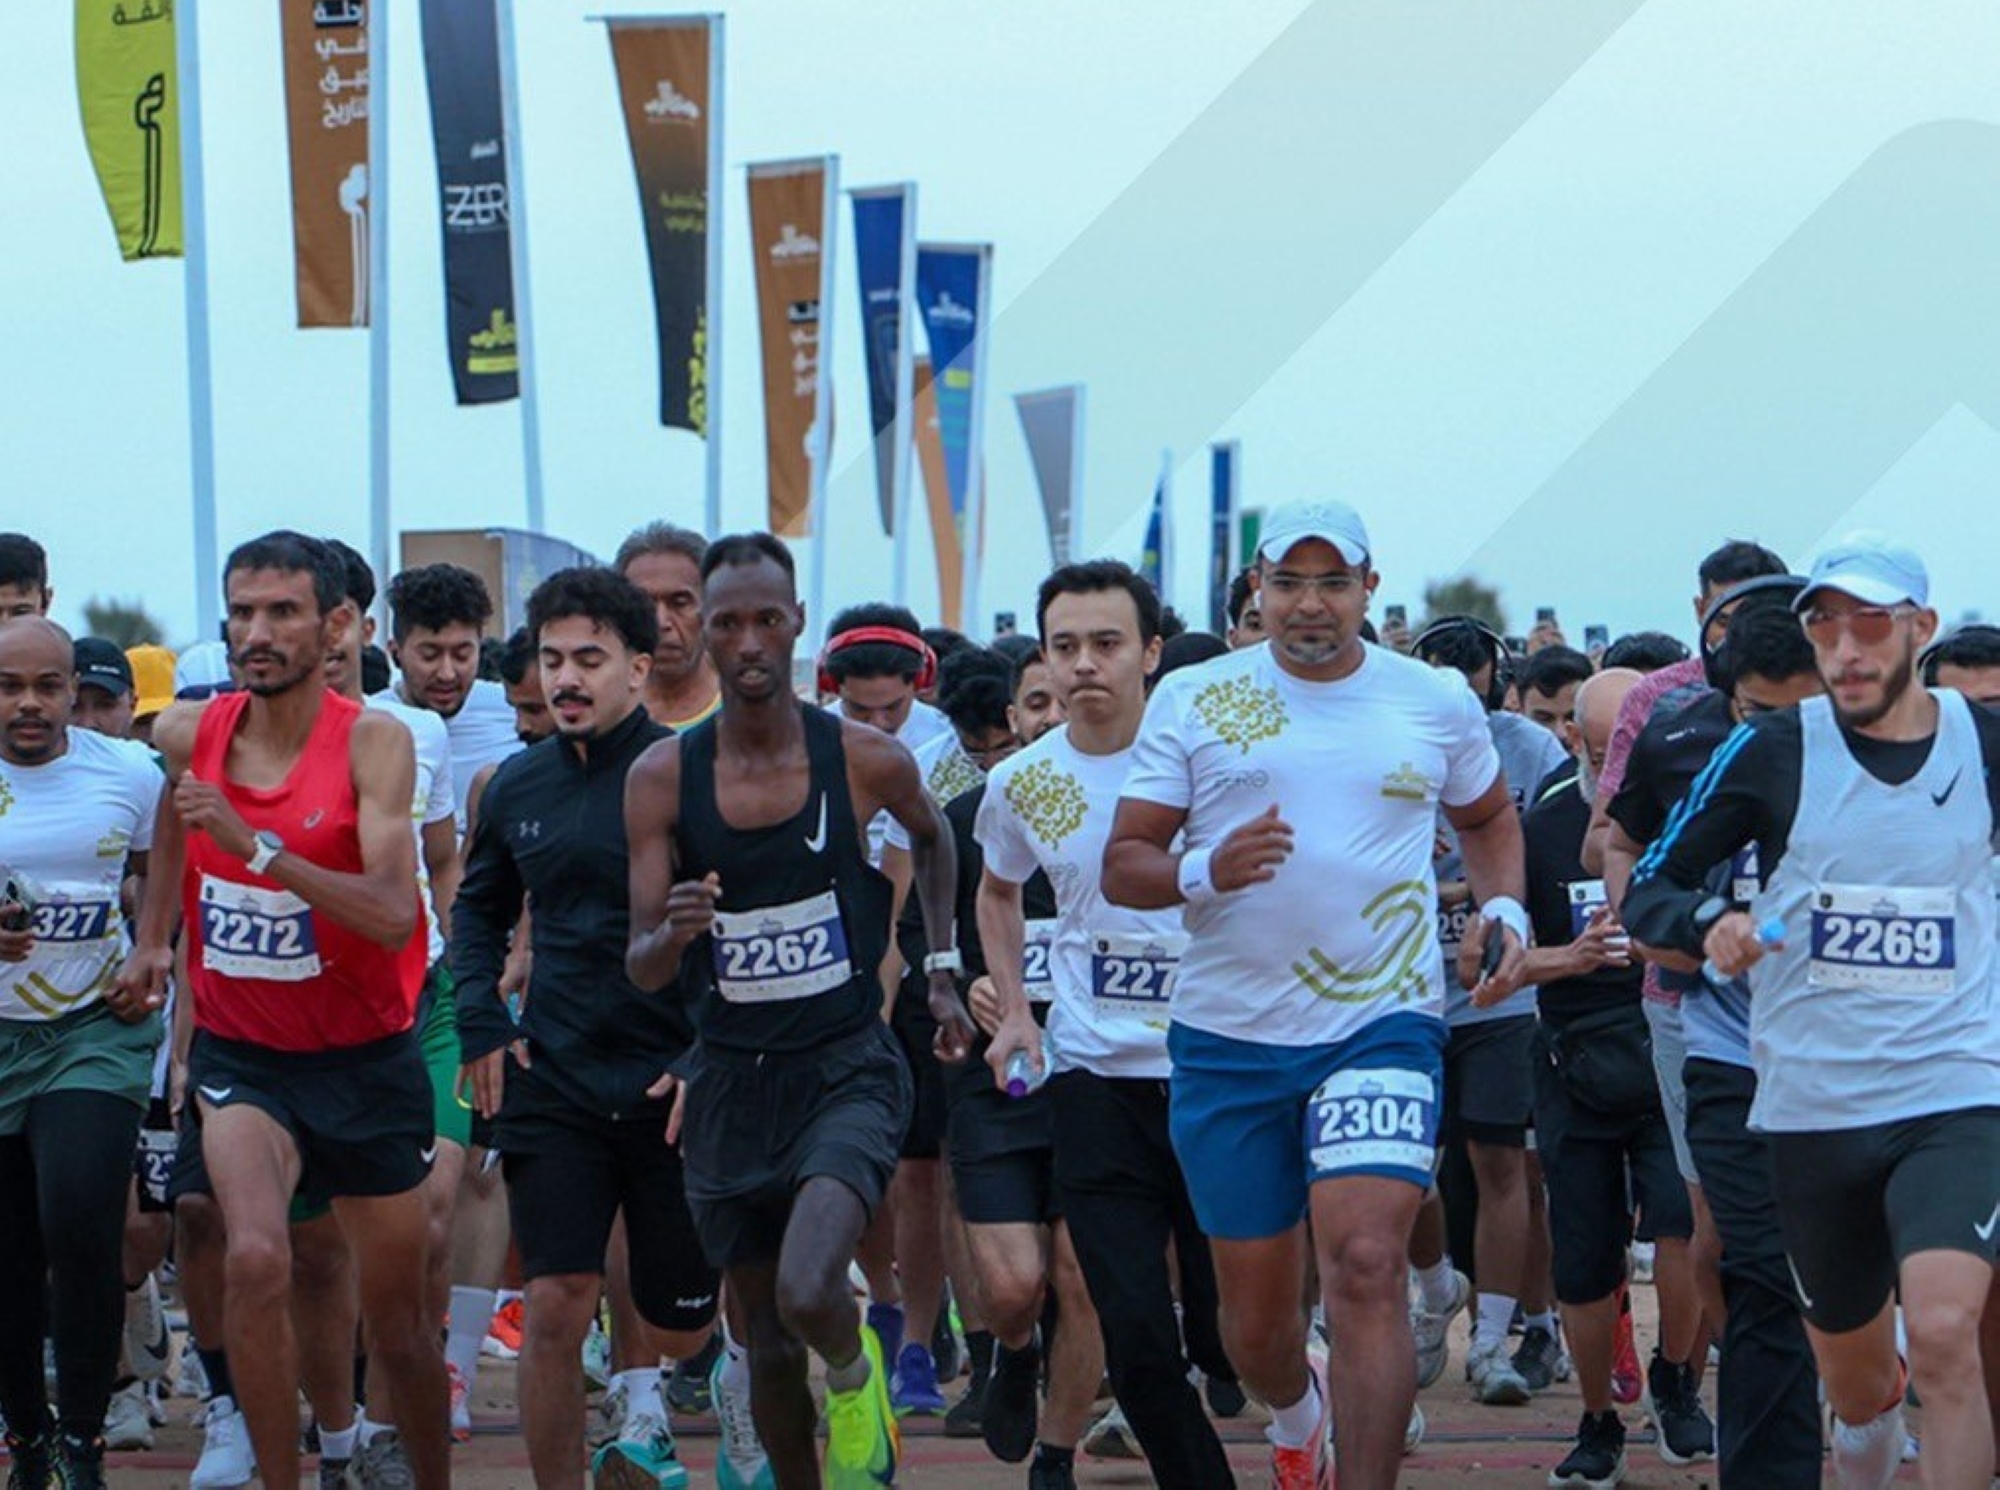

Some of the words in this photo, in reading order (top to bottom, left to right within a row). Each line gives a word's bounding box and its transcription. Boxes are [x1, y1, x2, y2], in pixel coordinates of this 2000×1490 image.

[31, 905, 100, 940] 327
[207, 908, 303, 955] 2272
[1822, 917, 1941, 965] 2269
[721, 926, 834, 977] 2262
[1103, 959, 1179, 998] 227
[1318, 1097, 1424, 1142] 2304
